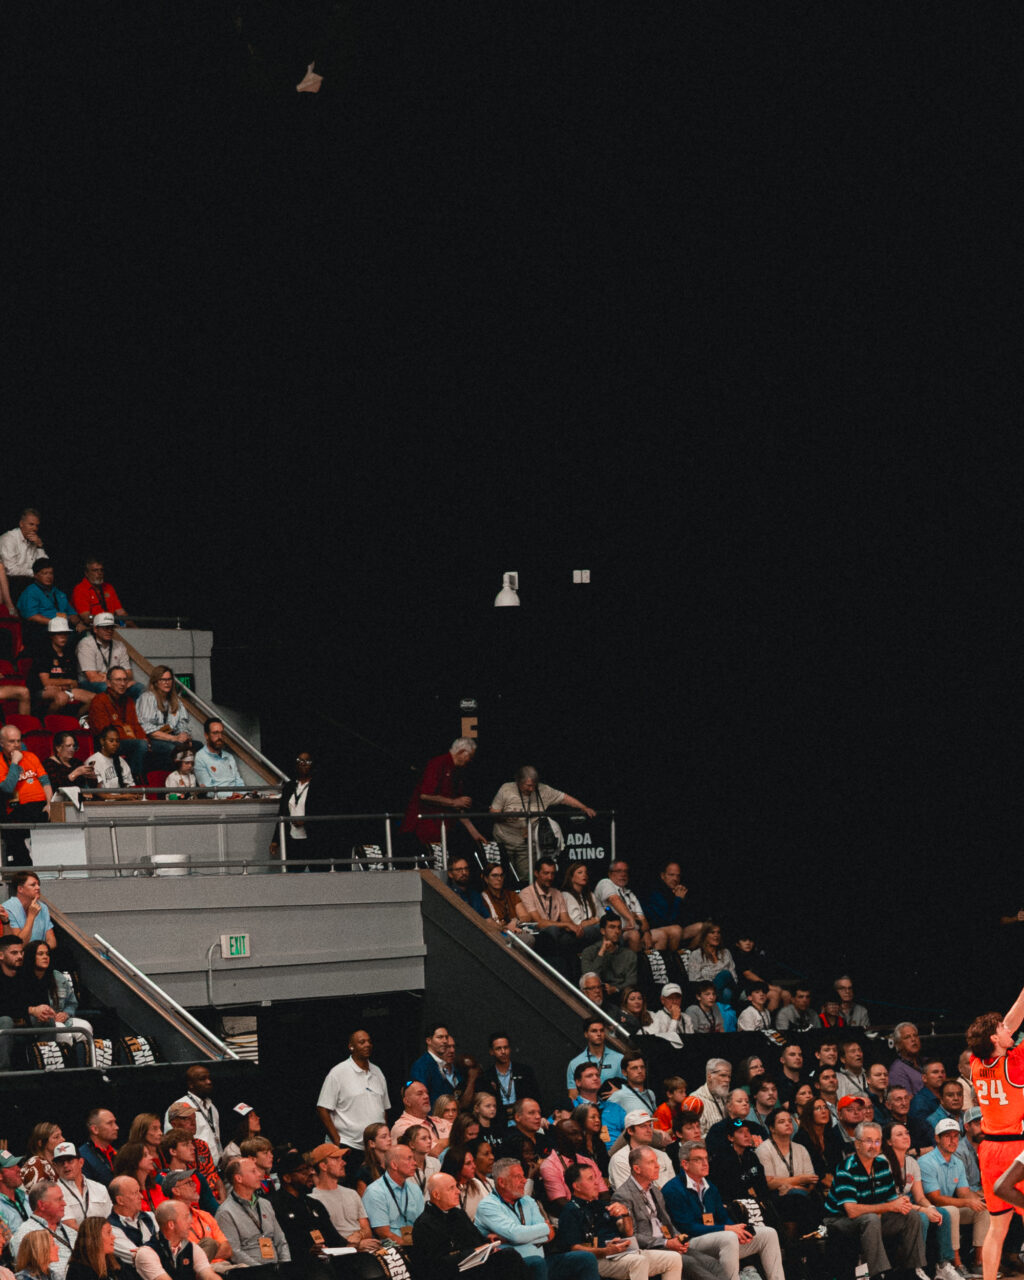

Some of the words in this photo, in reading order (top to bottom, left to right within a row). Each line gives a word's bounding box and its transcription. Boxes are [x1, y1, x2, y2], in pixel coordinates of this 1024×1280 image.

[566, 832, 592, 846] ADA
[568, 846, 605, 860] ATING
[229, 935, 246, 956] EXIT
[975, 1079, 1009, 1106] 24
